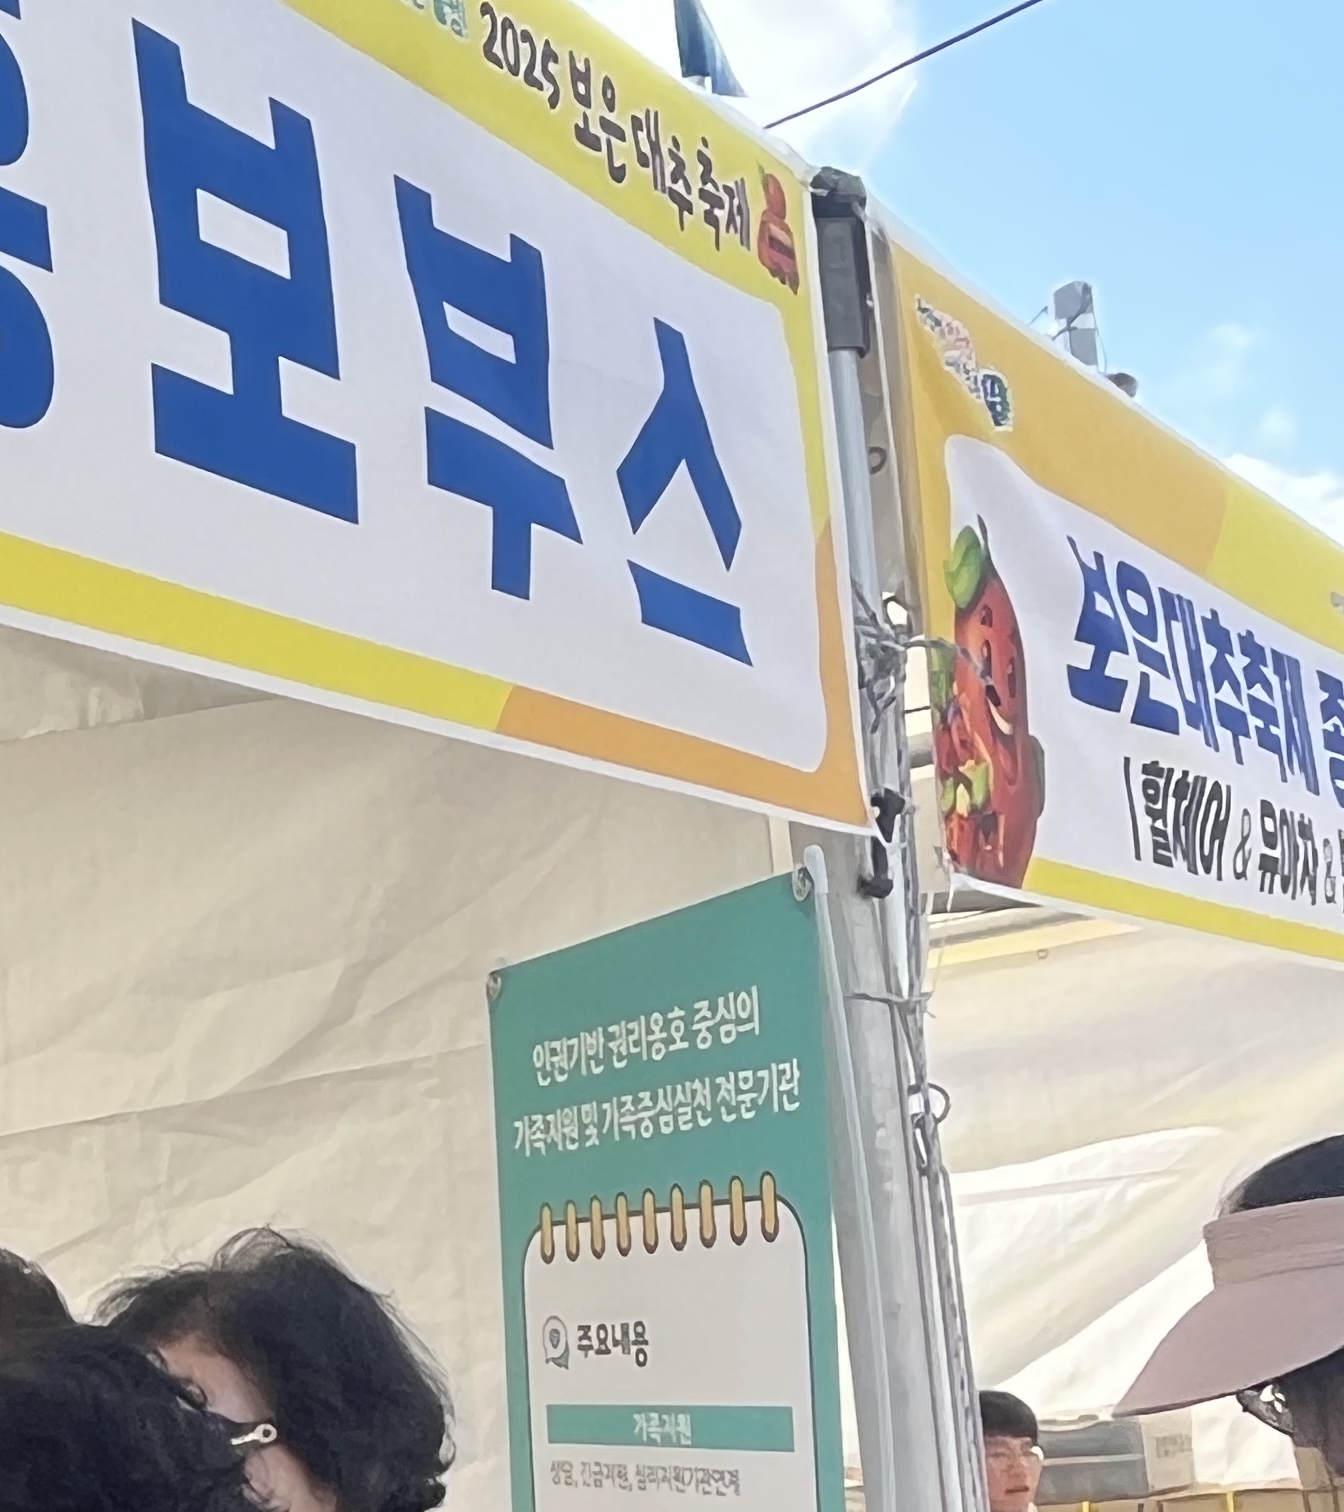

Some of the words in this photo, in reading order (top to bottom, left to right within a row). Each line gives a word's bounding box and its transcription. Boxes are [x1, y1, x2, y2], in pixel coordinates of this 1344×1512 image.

[480, 1, 560, 109] 2025
[1067, 535, 1320, 797] 보은대추축제
[1233, 808, 1252, 880] &
[533, 1027, 604, 1086] 인권기반
[608, 1006, 689, 1069] 권리옹호
[692, 985, 760, 1049] 중심의
[514, 1106, 579, 1157] 가족지원
[581, 1100, 600, 1147] 및
[602, 1077, 712, 1141] 가족중심실천
[715, 1058, 800, 1123] 전문기관
[577, 1320, 649, 1367] 주요내용
